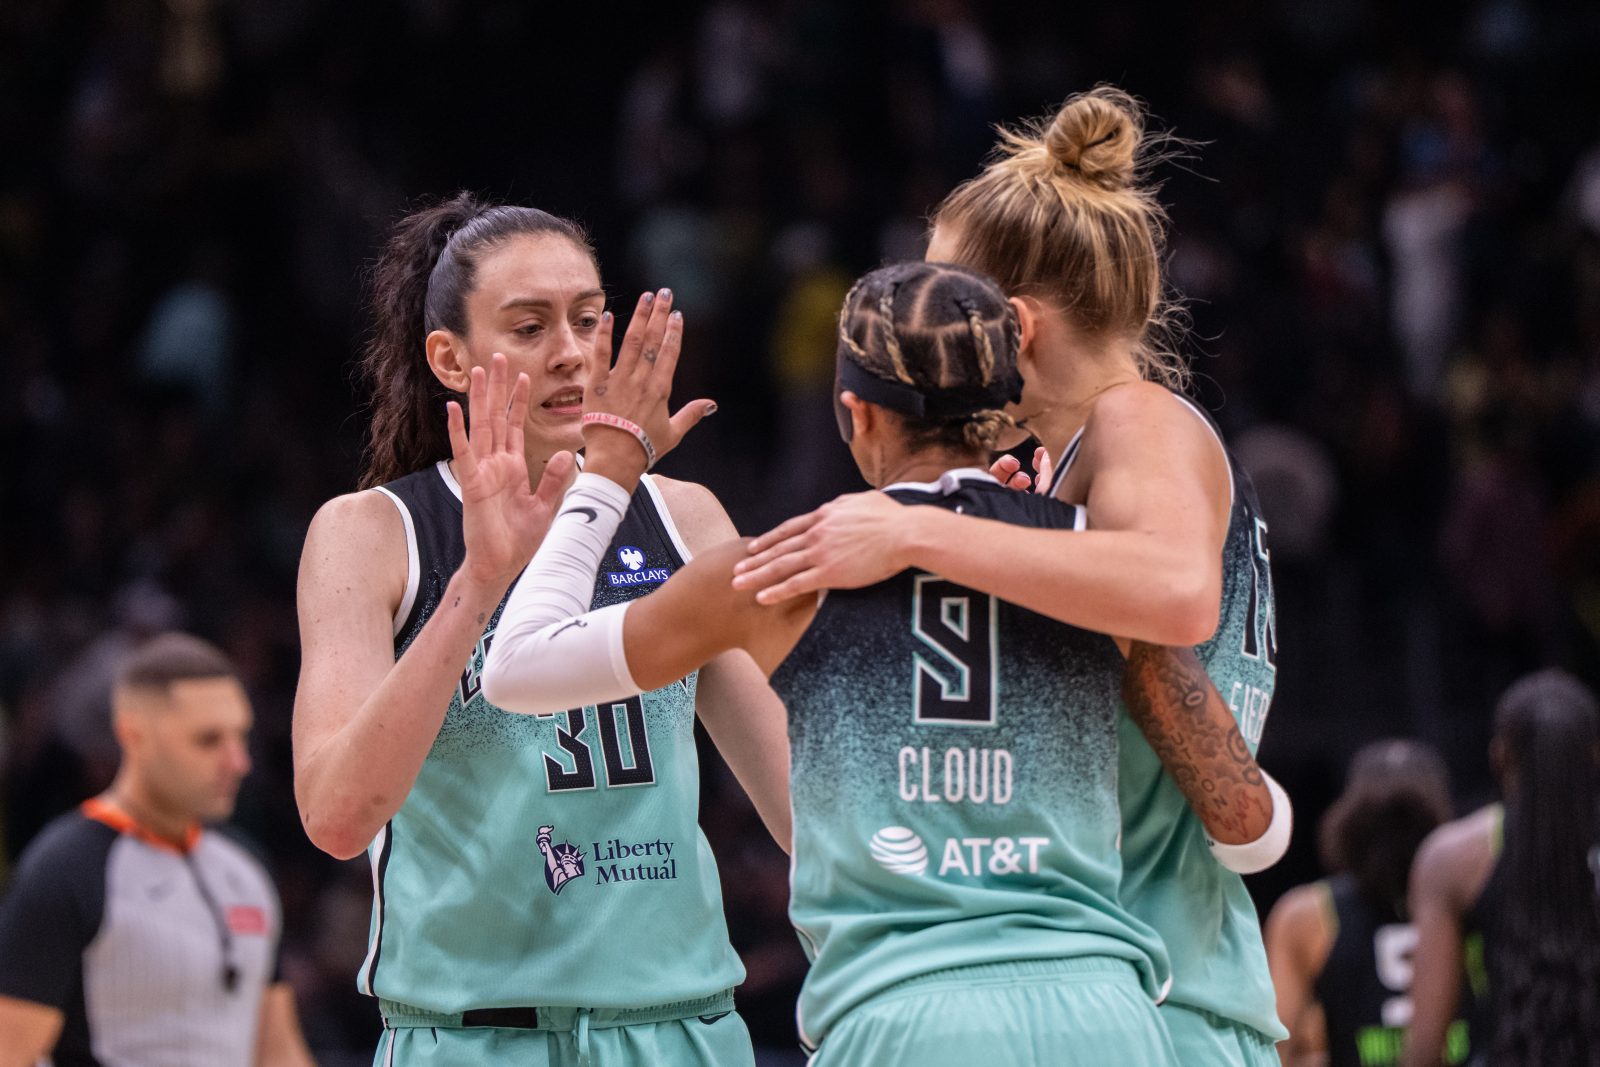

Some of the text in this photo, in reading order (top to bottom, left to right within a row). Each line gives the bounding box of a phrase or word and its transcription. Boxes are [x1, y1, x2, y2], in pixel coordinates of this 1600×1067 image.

[610, 569, 669, 584] BARCLAYS
[912, 574, 998, 726] 9
[537, 693, 656, 793] 30
[898, 746, 1013, 804] CLOUD
[592, 838, 674, 864] Liberty
[938, 837, 1050, 877] AT&T
[594, 859, 678, 886] Mutual
